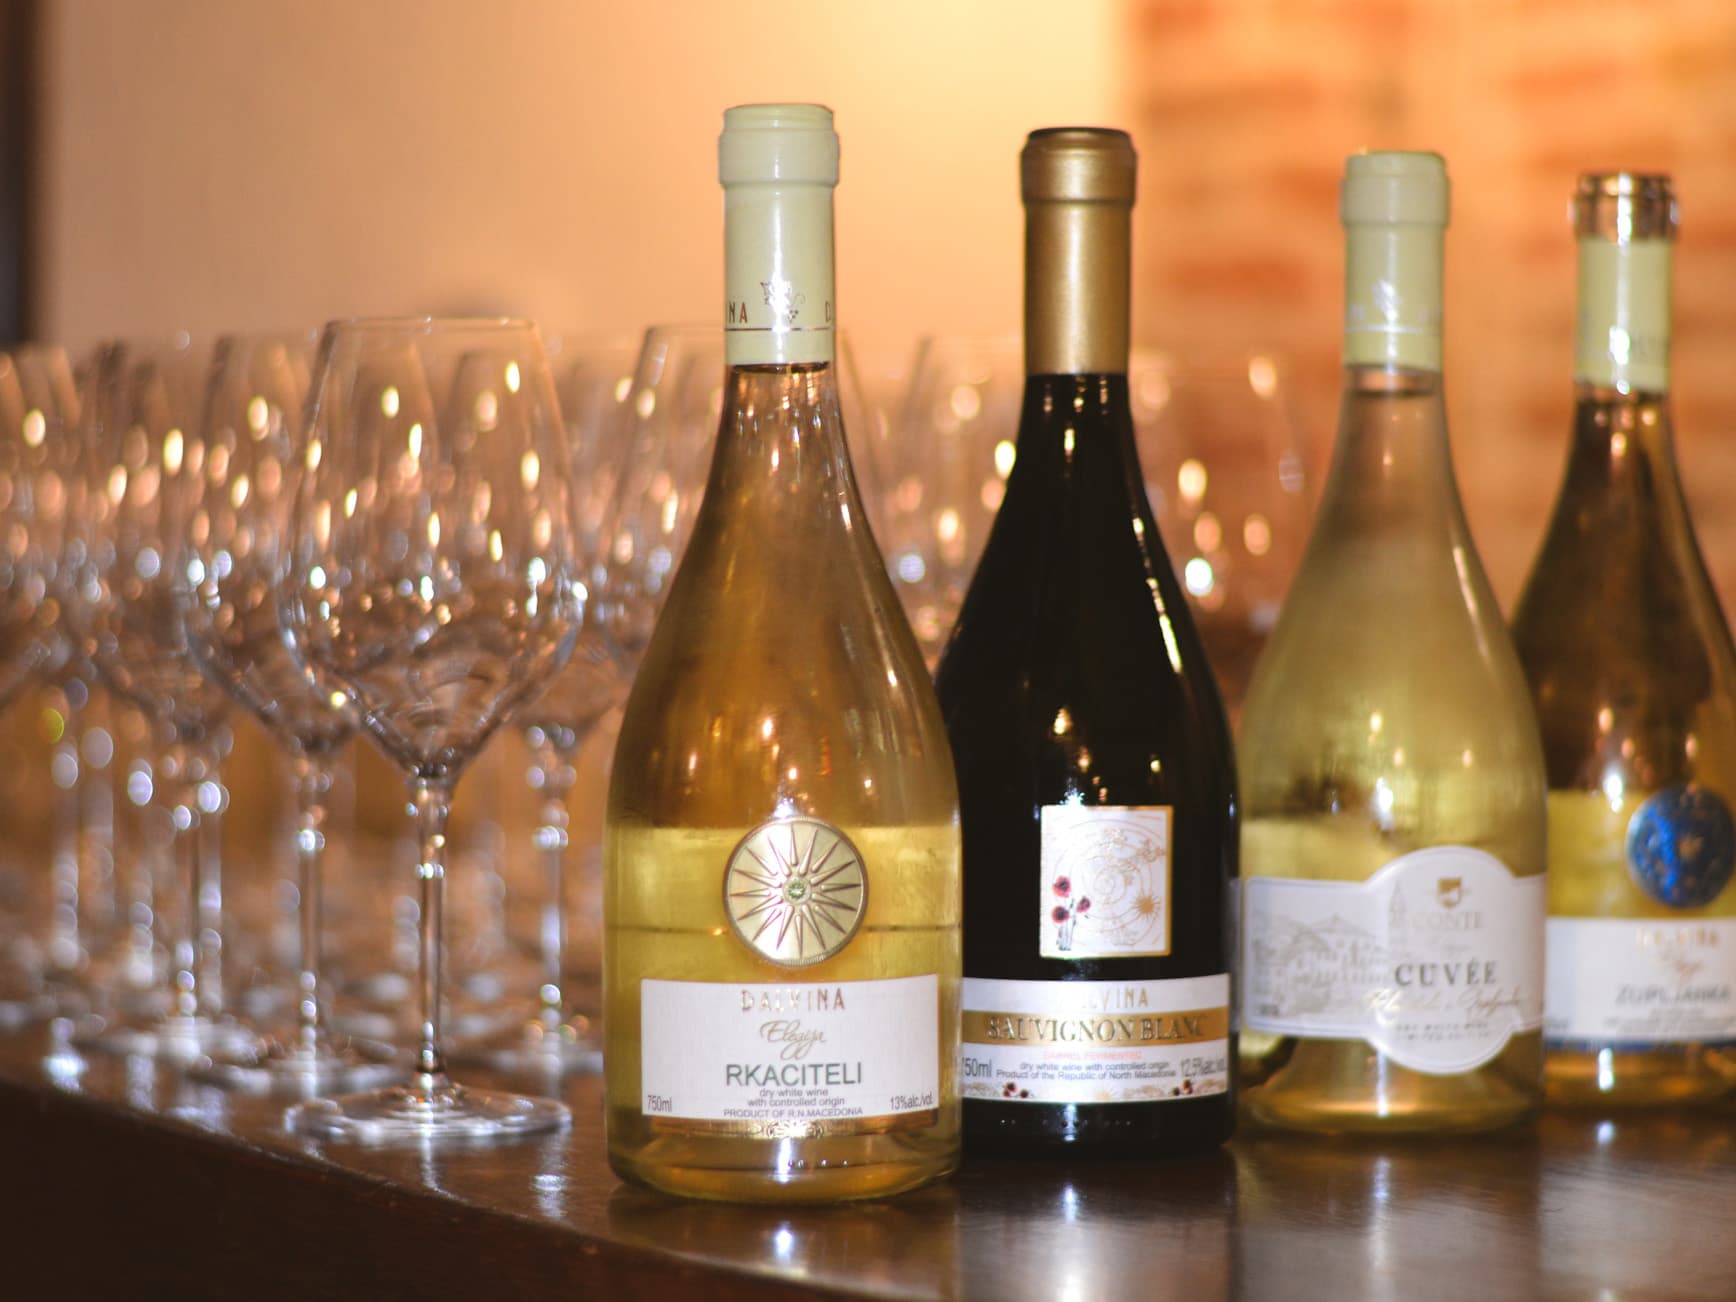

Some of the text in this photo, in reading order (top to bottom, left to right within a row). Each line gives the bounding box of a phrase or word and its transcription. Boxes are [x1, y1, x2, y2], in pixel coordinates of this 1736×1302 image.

[1394, 958, 1498, 987] CUVÉE
[987, 1016, 1136, 1042] SAUVIGNON
[725, 1061, 862, 1087] RKACITELI
[962, 1057, 993, 1078] 50ml
[1019, 1062, 1034, 1073] dry
[1036, 1062, 1060, 1071] white
[1085, 1061, 1103, 1071] with
[1105, 1061, 1146, 1071] controlled
[996, 1069, 1029, 1079] Product
[1031, 1069, 1041, 1079] of
[1043, 1069, 1056, 1079] the
[1058, 1070, 1096, 1081] Republic
[1098, 1069, 1107, 1079] of
[1109, 1070, 1132, 1079] North
[760, 1087, 829, 1099] dry white wine
[647, 1095, 673, 1113] 750ml
[747, 1097, 845, 1109] with controlled origin
[723, 1109, 769, 1118] PRODUCT
[772, 1109, 785, 1118] OF
